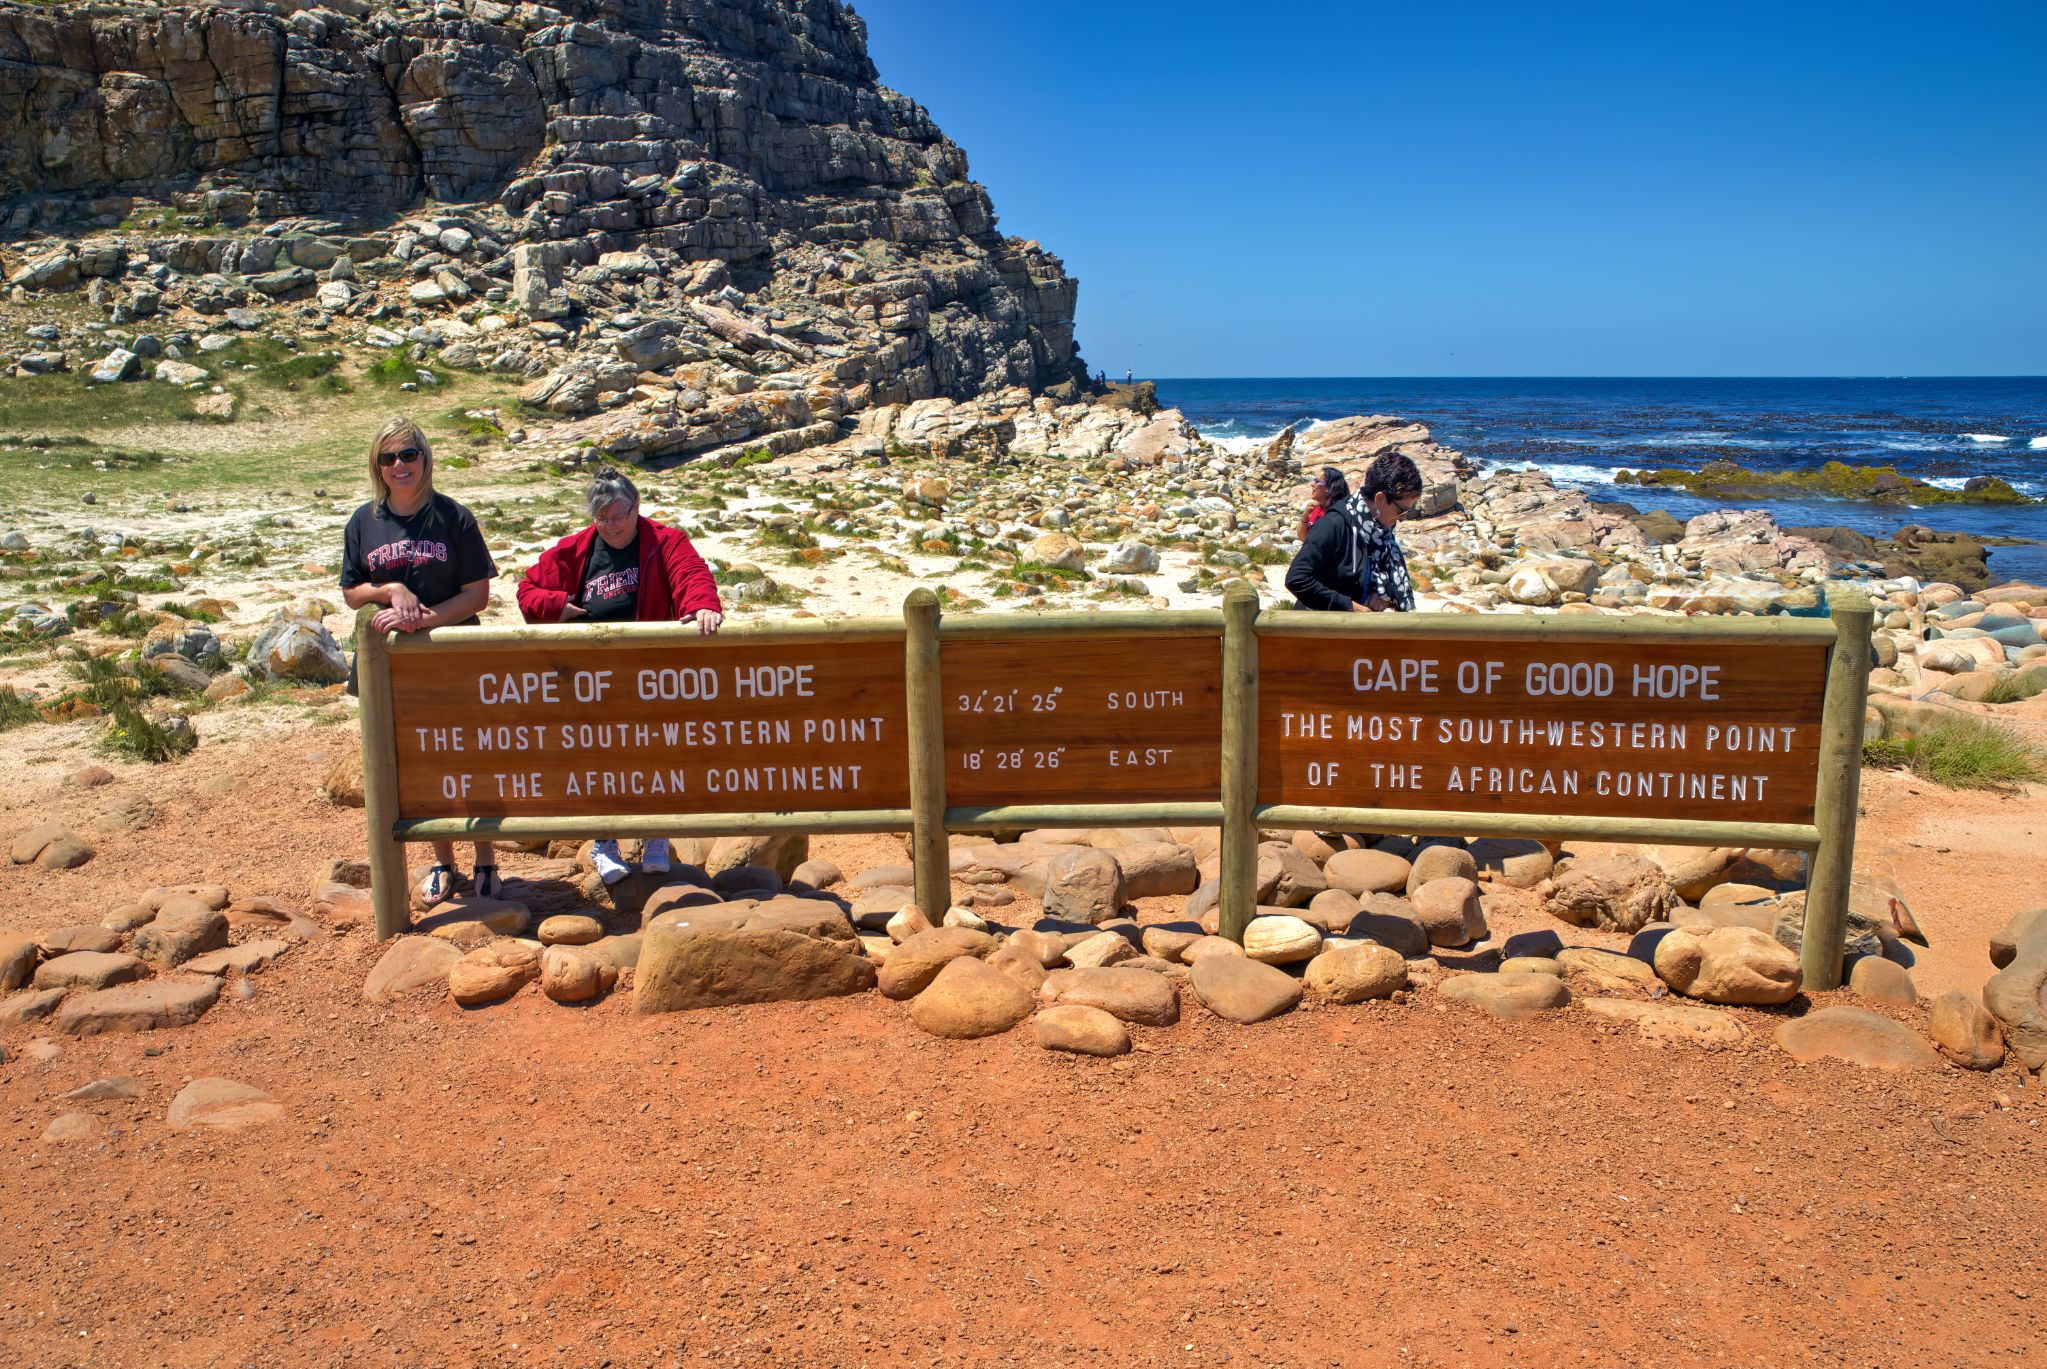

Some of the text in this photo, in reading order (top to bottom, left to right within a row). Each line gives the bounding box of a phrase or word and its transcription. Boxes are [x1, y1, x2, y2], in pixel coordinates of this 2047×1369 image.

[367, 540, 447, 571] FRIENDS
[586, 568, 638, 601] FRIEN
[478, 664, 815, 705] CAPE OF GOOD HOPE
[1353, 658, 1721, 701] CAPE OF GOOD HOPE
[1107, 690, 1183, 709] SOUTH
[416, 717, 884, 752] THE MOST SOUTH-WESTERN POINT
[1282, 713, 1796, 753] THE MOST SOUTH-WESTERN POINT
[1109, 748, 1173, 767] EAST
[442, 765, 862, 800] OF THE AFRICAN CONTINENT
[1307, 761, 1769, 802] OF THE AFRICAN CONTINENT
